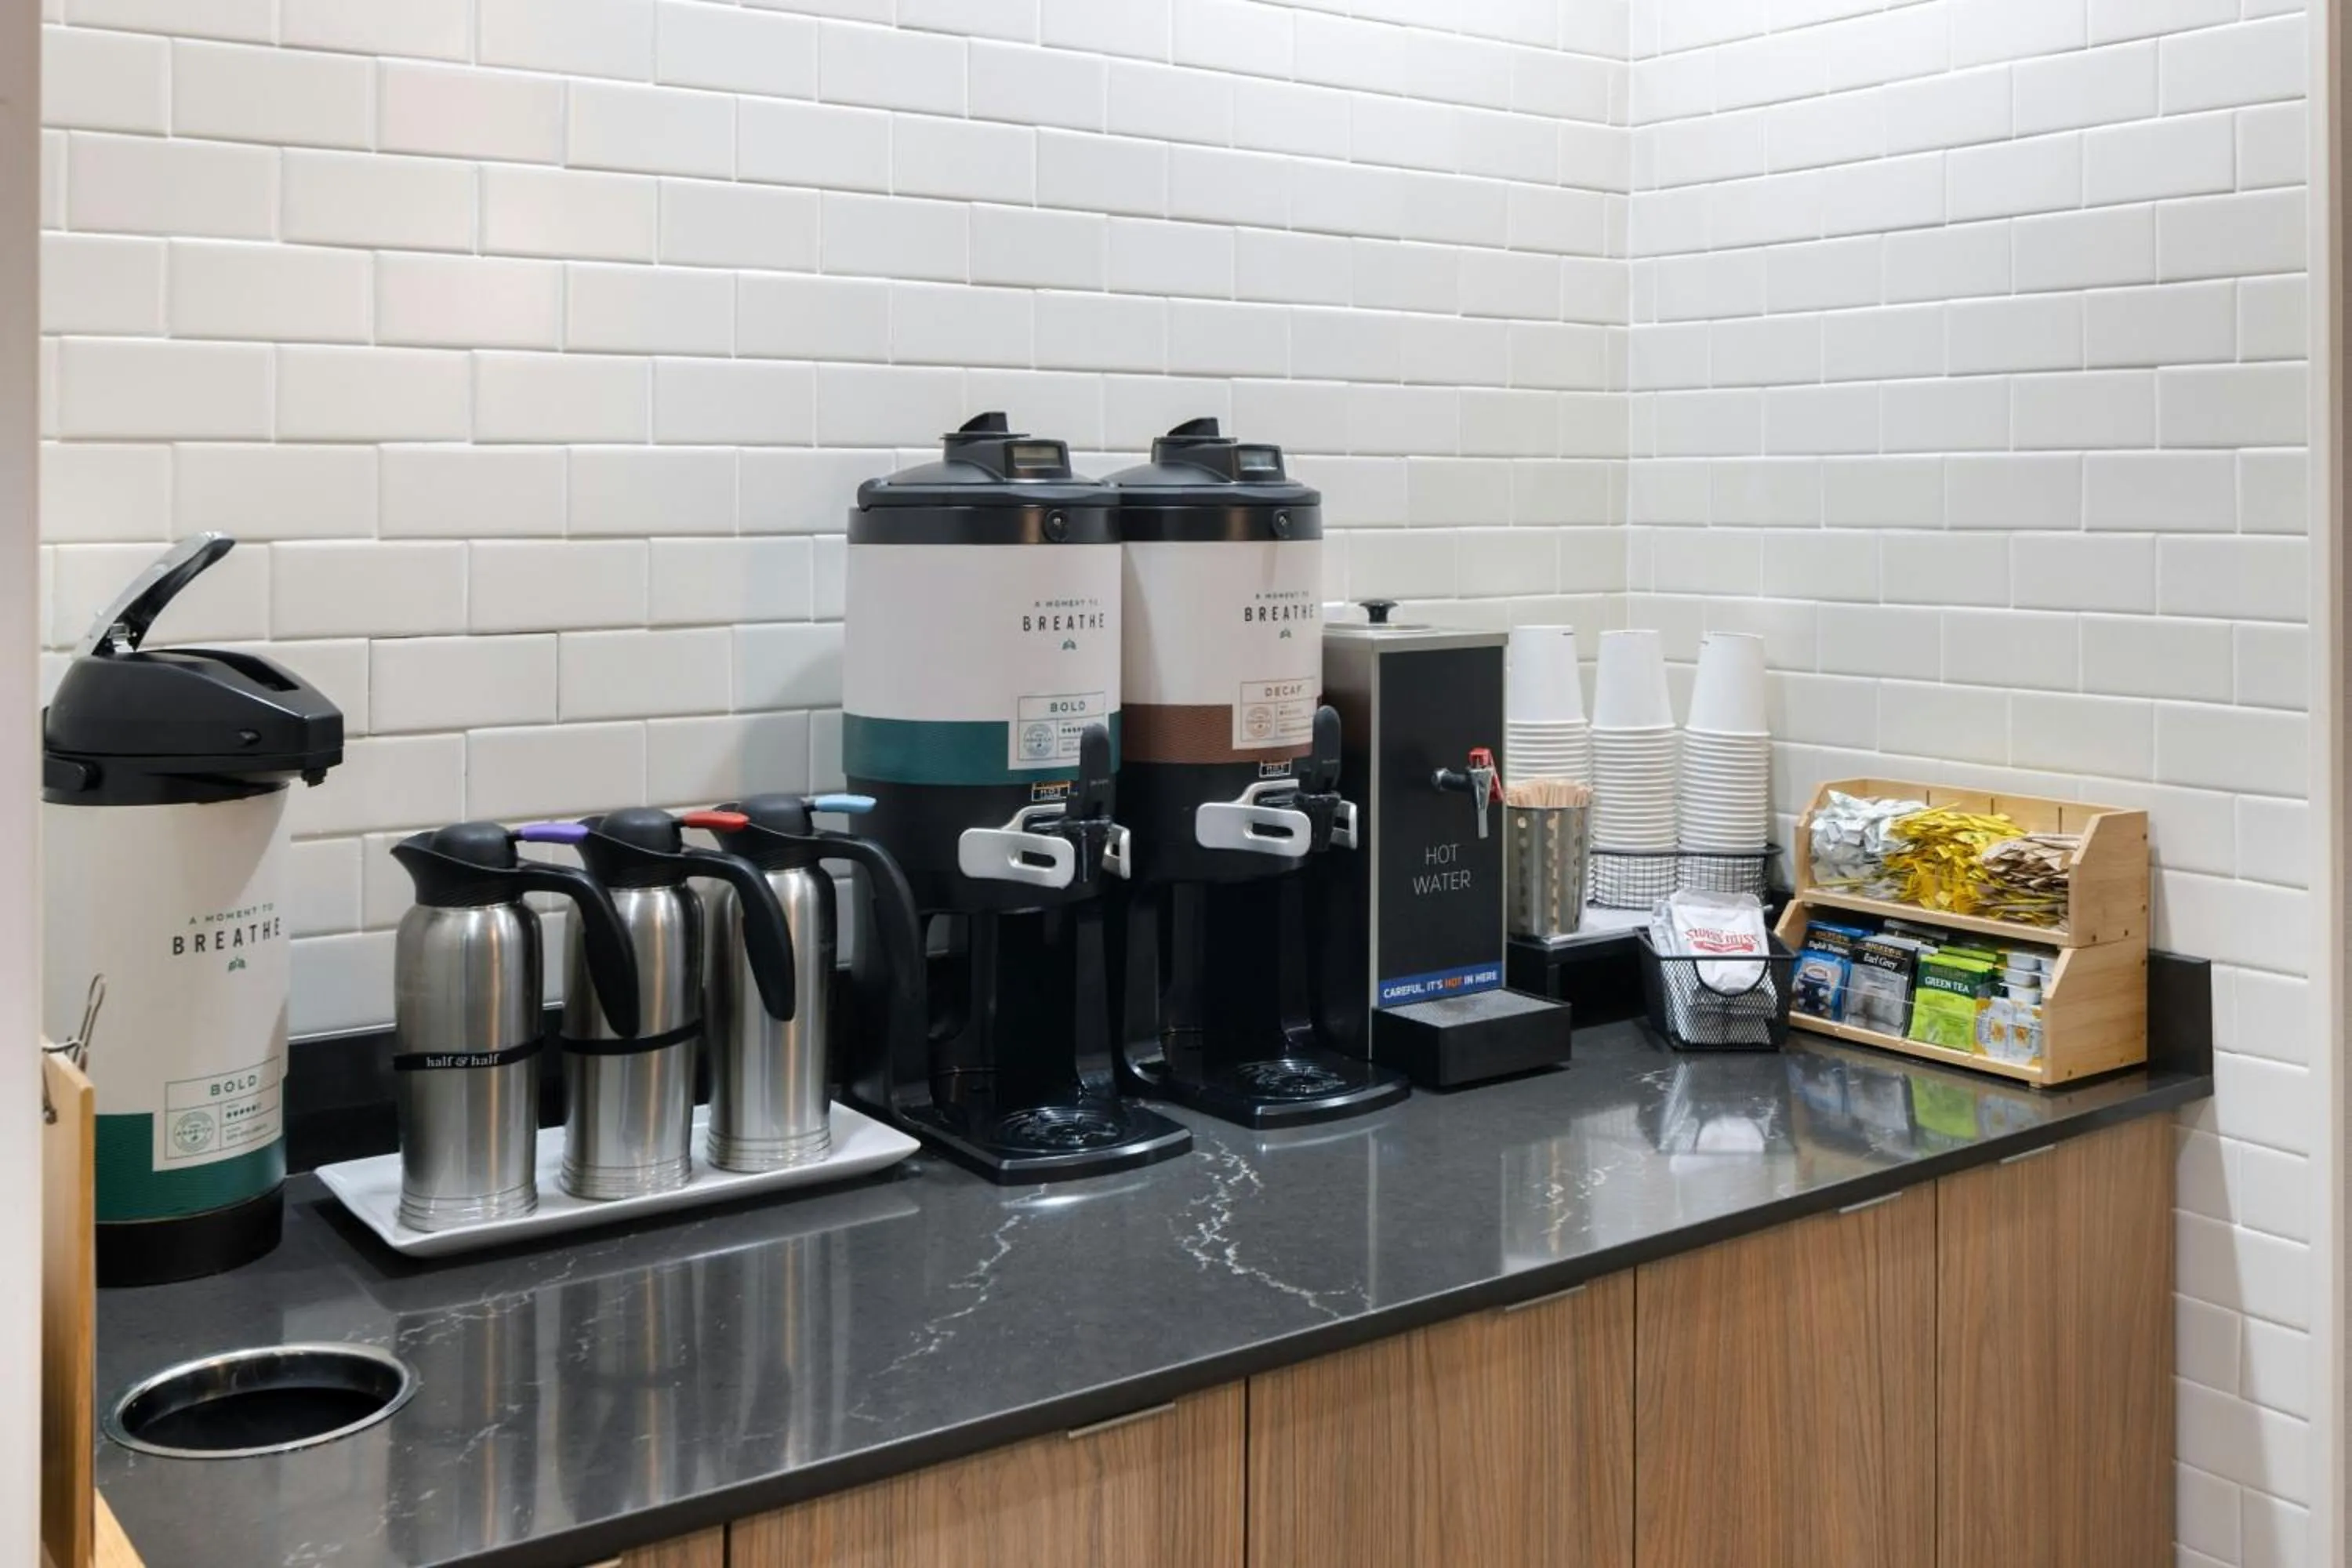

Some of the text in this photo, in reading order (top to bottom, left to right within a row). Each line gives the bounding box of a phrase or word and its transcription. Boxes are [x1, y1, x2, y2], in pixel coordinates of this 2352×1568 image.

[1022, 612, 1104, 632] BREATHE
[1244, 604, 1314, 622] BREATHE
[1265, 684, 1303, 697] DECAF
[1050, 701, 1086, 713] BOLD
[1425, 844, 1460, 865] HOT
[1413, 869, 1471, 895] WATER
[189, 916, 197, 925] A
[205, 906, 257, 922] MOMENT
[172, 916, 280, 955] BREATHE
[1864, 953, 1879, 964] Earl
[1464, 975, 1473, 985] IN
[1475, 970, 1497, 982] HERE
[1925, 976, 1970, 993] GREEN TEA
[426, 1056, 452, 1067] half
[471, 1054, 500, 1066] half
[210, 1075, 257, 1096] BOLD
